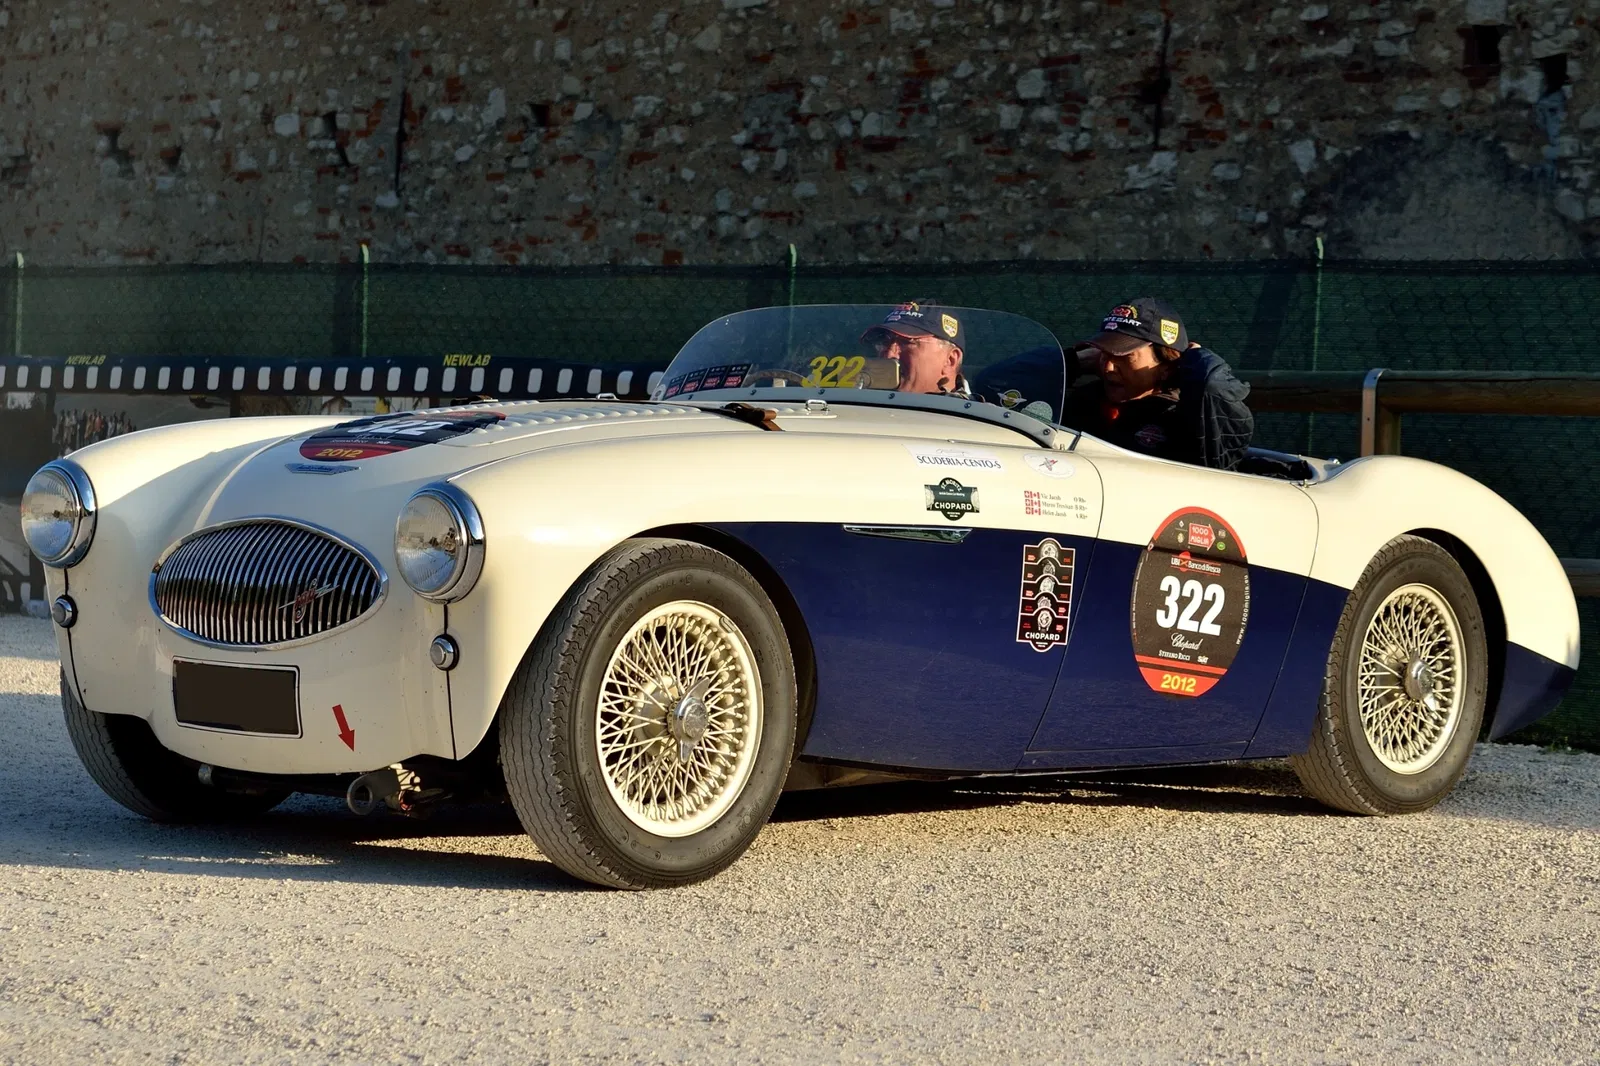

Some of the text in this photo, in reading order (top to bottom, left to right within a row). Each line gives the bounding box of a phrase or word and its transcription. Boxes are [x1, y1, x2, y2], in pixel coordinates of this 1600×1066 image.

[65, 355, 106, 365] NEWLAB
[443, 354, 491, 366] NEWLAB
[801, 356, 866, 388] 322
[315, 448, 364, 458] 2012
[916, 455, 1002, 469] SCUDERIA-CENTO-S
[934, 501, 973, 511] CHOPARD
[1192, 526, 1209, 536] 1000
[1156, 575, 1226, 636] 322
[1025, 631, 1060, 641] CHOPARD
[1171, 632, 1204, 650] Chopard
[1160, 674, 1197, 693] 2012
